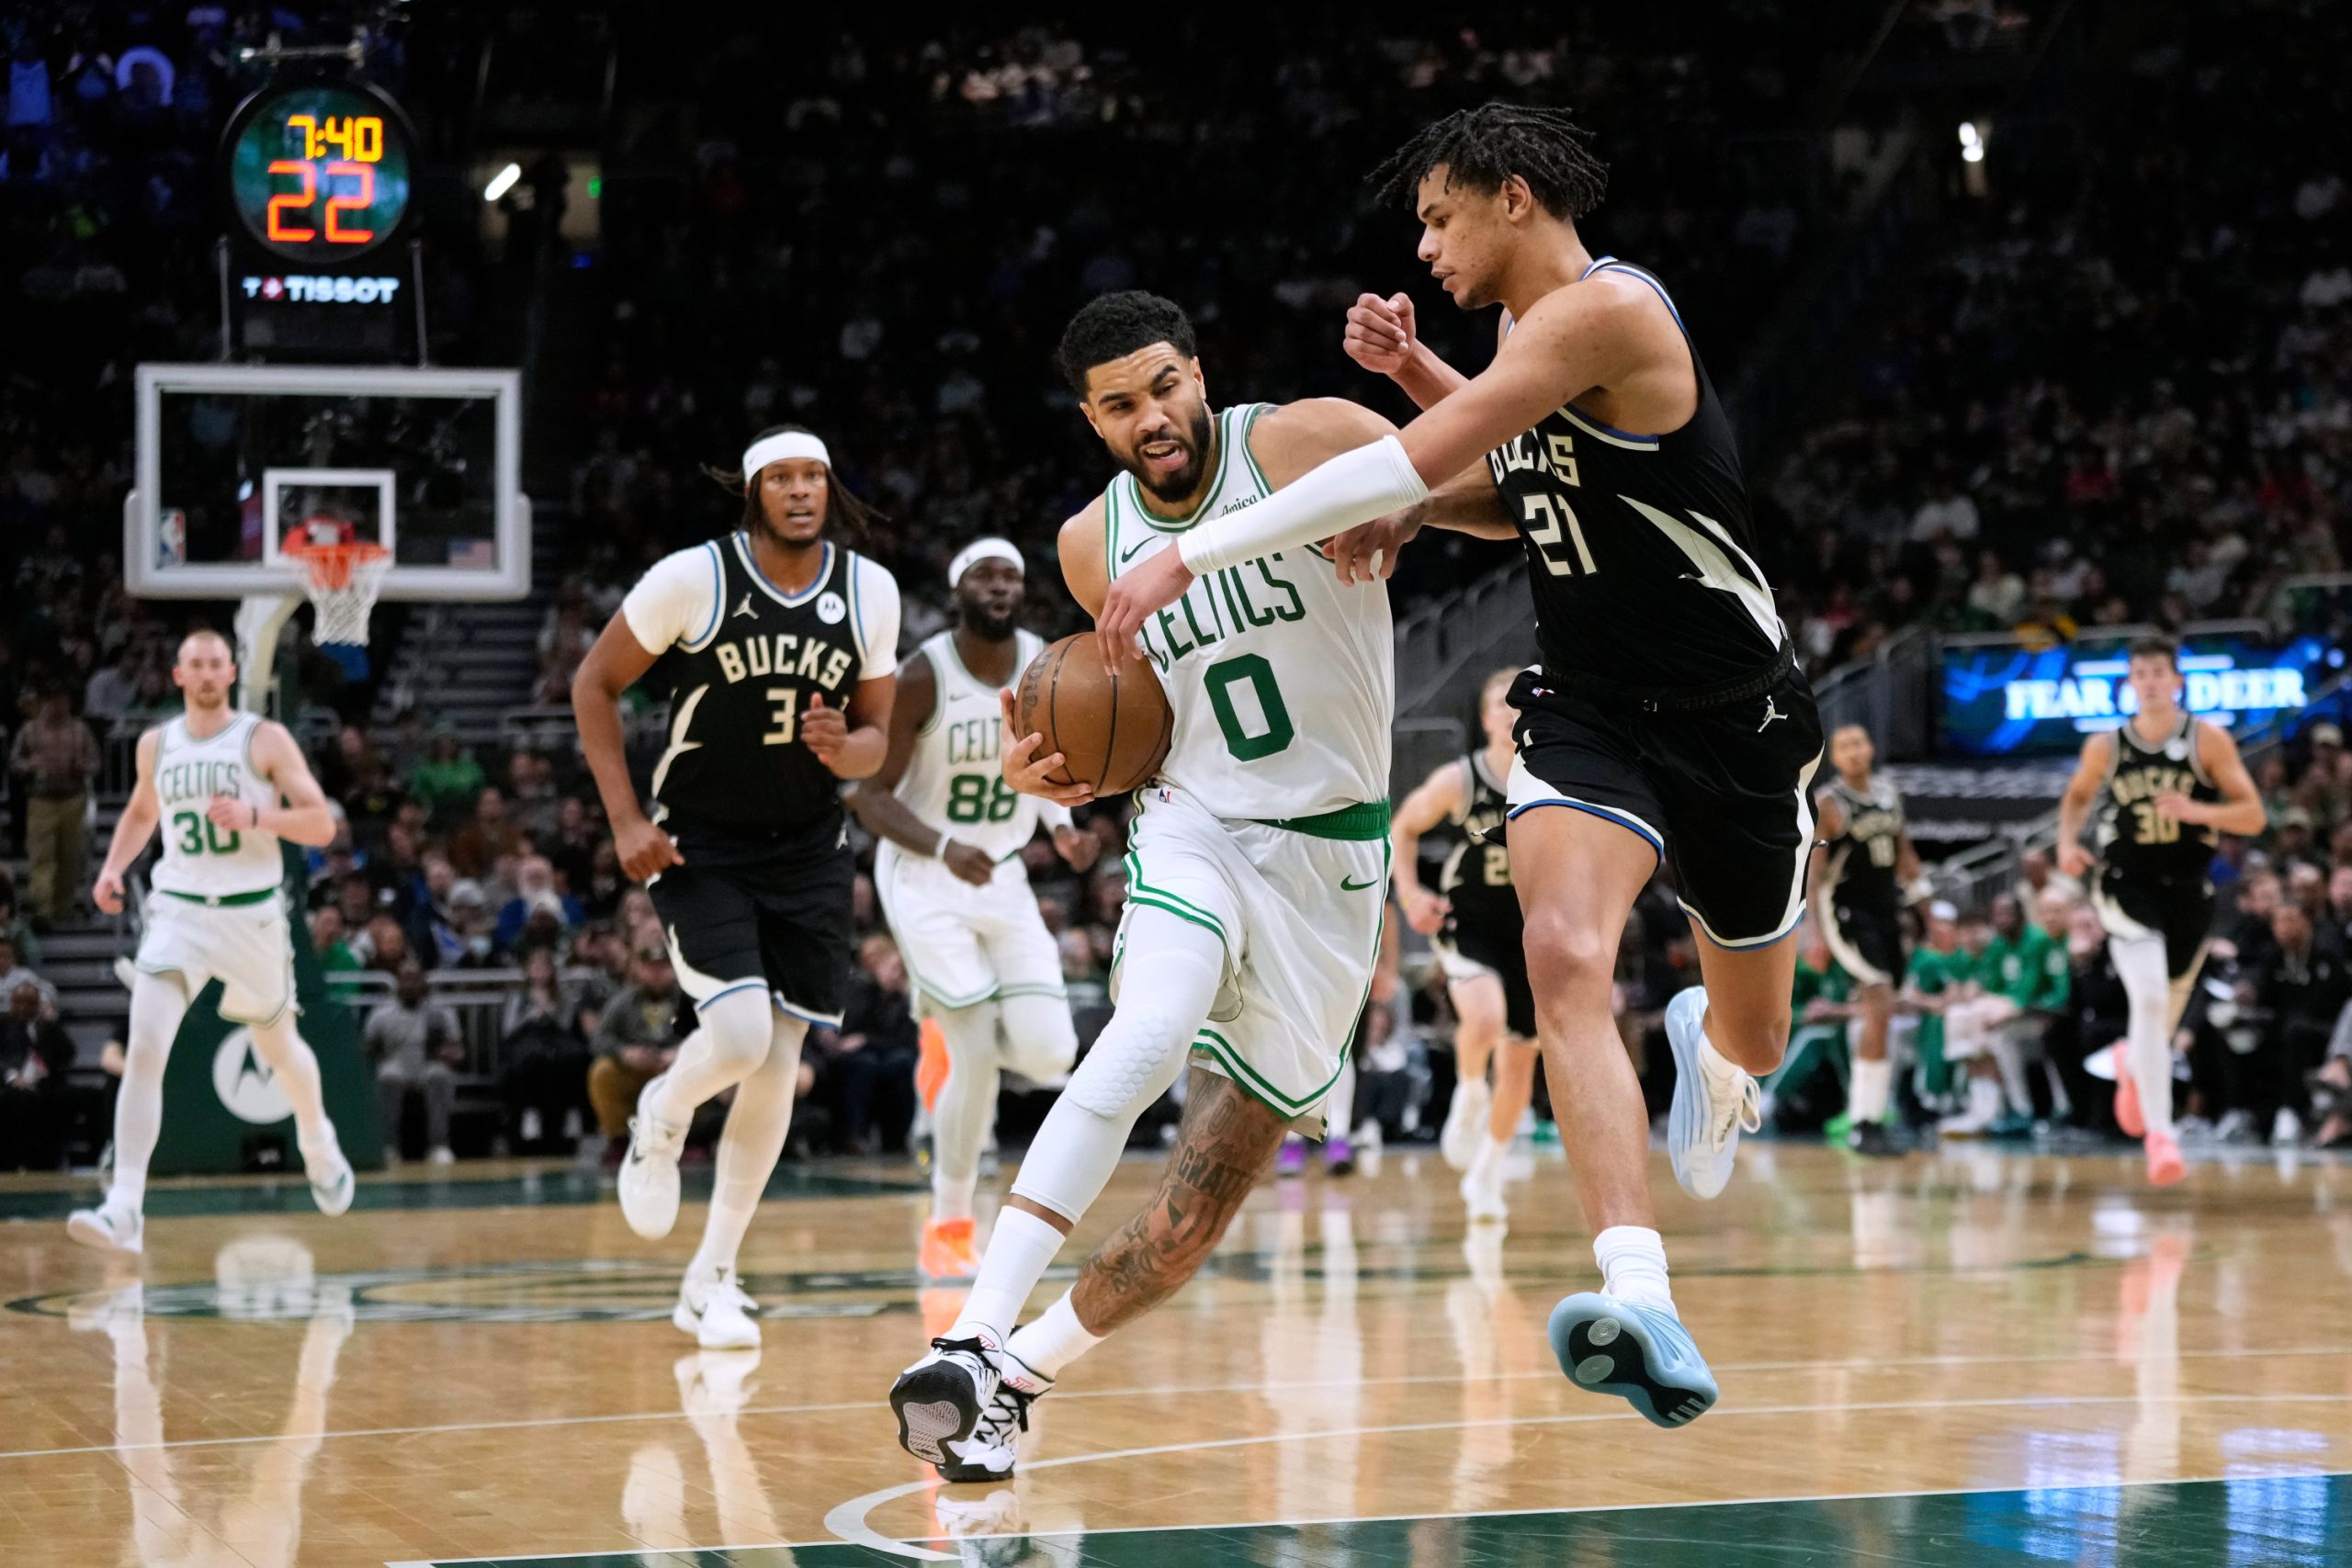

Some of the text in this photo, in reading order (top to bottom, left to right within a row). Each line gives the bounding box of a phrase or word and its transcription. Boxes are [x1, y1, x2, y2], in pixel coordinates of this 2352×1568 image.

[288, 115, 383, 163] 7:40
[267, 161, 374, 243] 22
[284, 276, 399, 303] TISSOT
[1522, 493, 1598, 576] 21
[715, 633, 853, 691] BUCKS
[763, 688, 797, 745] 3
[1204, 652, 1295, 762] 0
[2006, 677, 2115, 720] FEAR
[2185, 668, 2308, 712] DEER
[161, 761, 240, 806] CELTICS
[174, 811, 241, 855] 30
